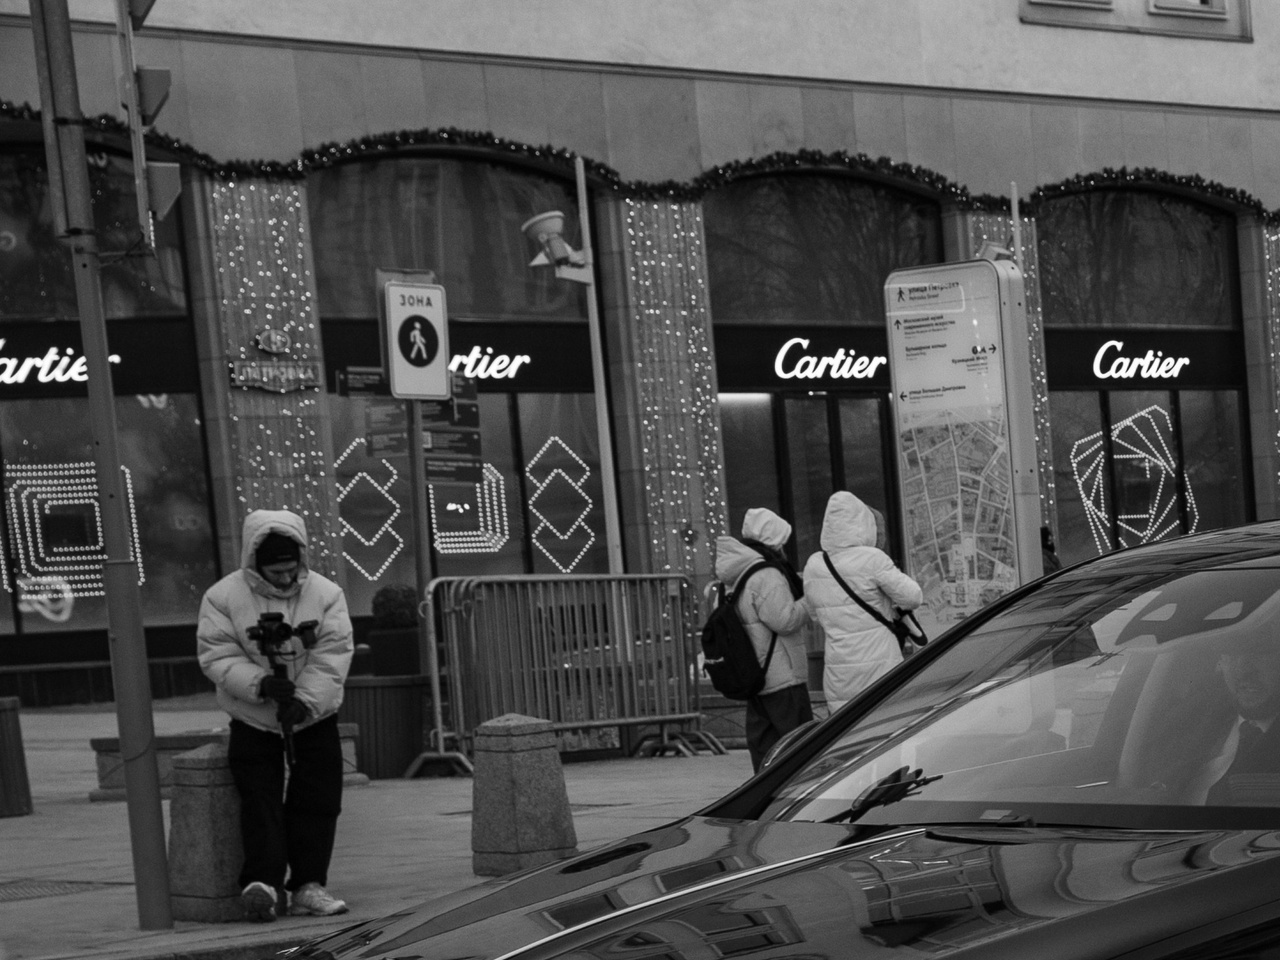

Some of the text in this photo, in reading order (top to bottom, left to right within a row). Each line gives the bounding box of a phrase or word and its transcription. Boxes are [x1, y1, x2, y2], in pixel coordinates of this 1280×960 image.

[399, 293, 433, 307] ЗОНА
[0, 338, 122, 384] artie
[447, 345, 531, 379] rtier
[774, 337, 887, 379] Cartier
[1092, 340, 1190, 379] Cartier
